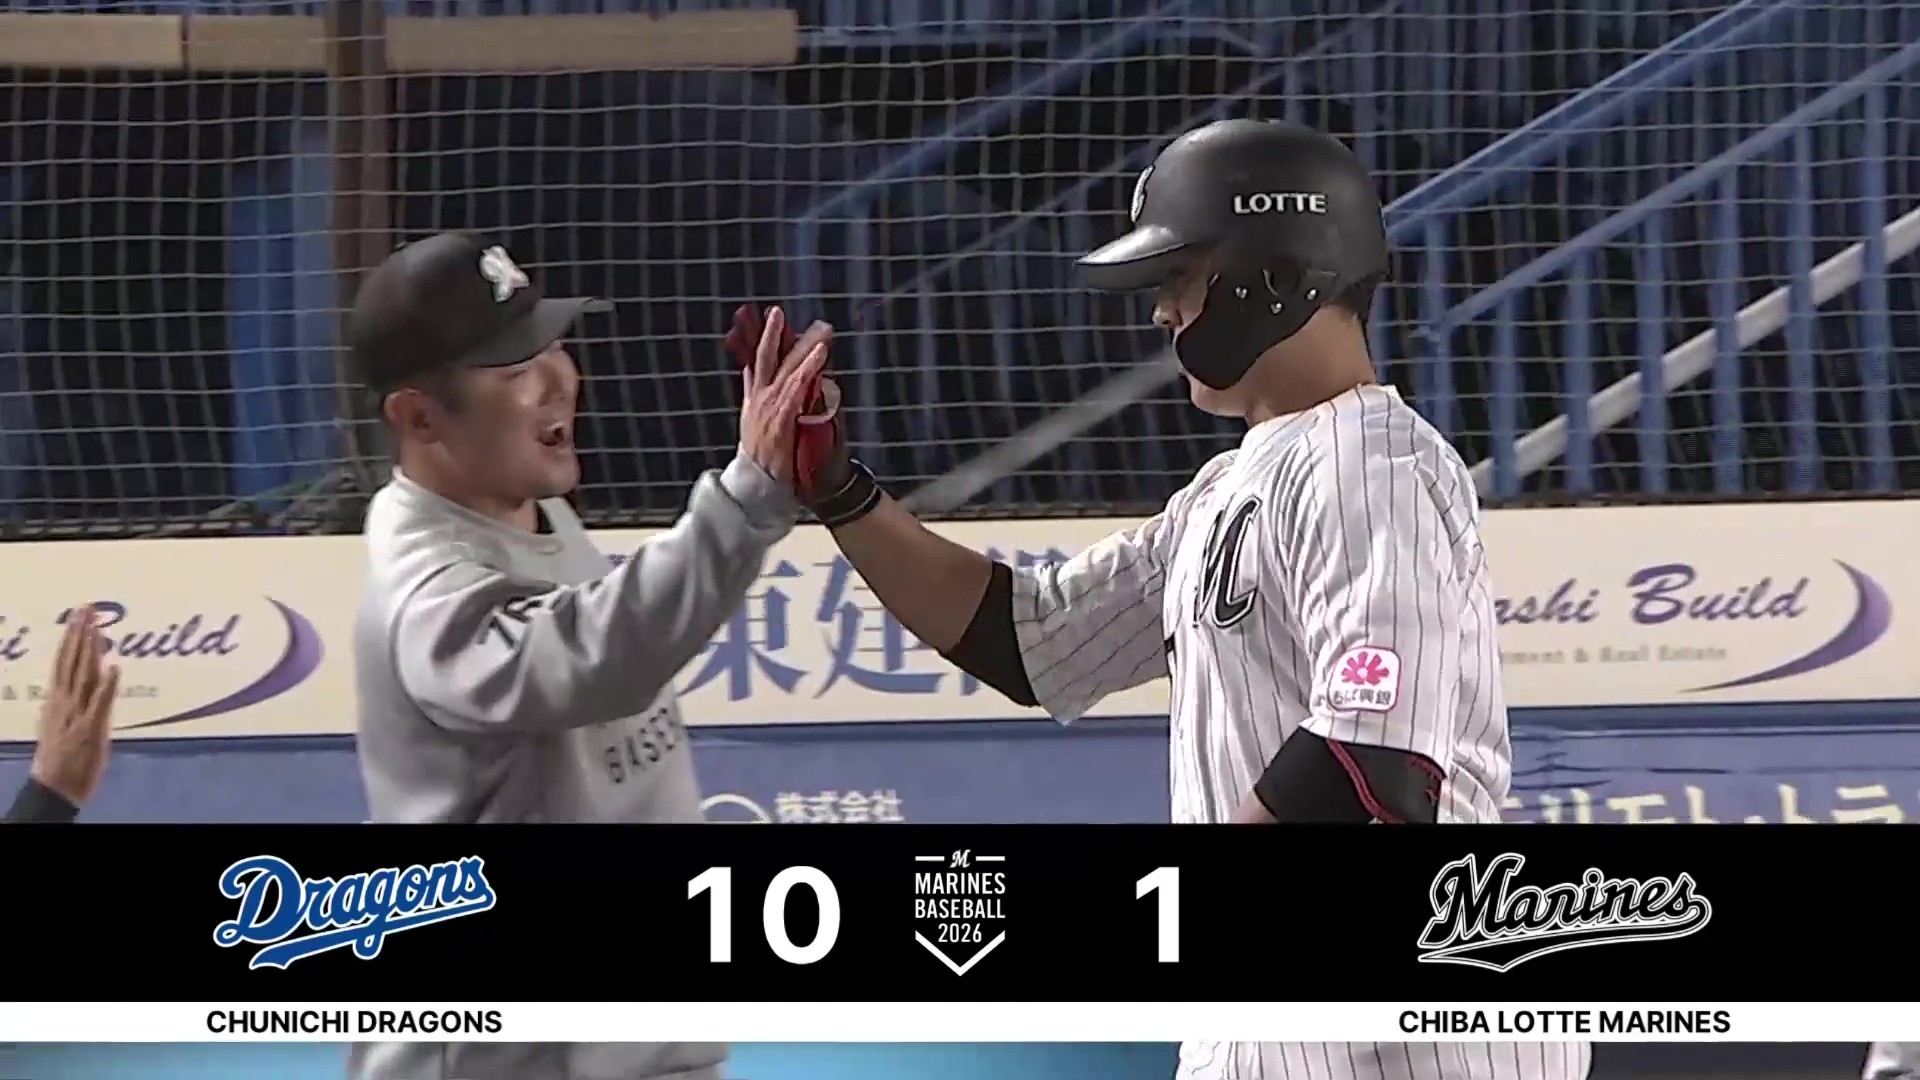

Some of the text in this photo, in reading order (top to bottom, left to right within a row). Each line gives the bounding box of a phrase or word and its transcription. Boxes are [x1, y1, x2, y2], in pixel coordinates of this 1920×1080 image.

[1234, 192, 1327, 215] LOTTE
[1626, 562, 1810, 625] Build
[774, 789, 904, 824] 株式会社
